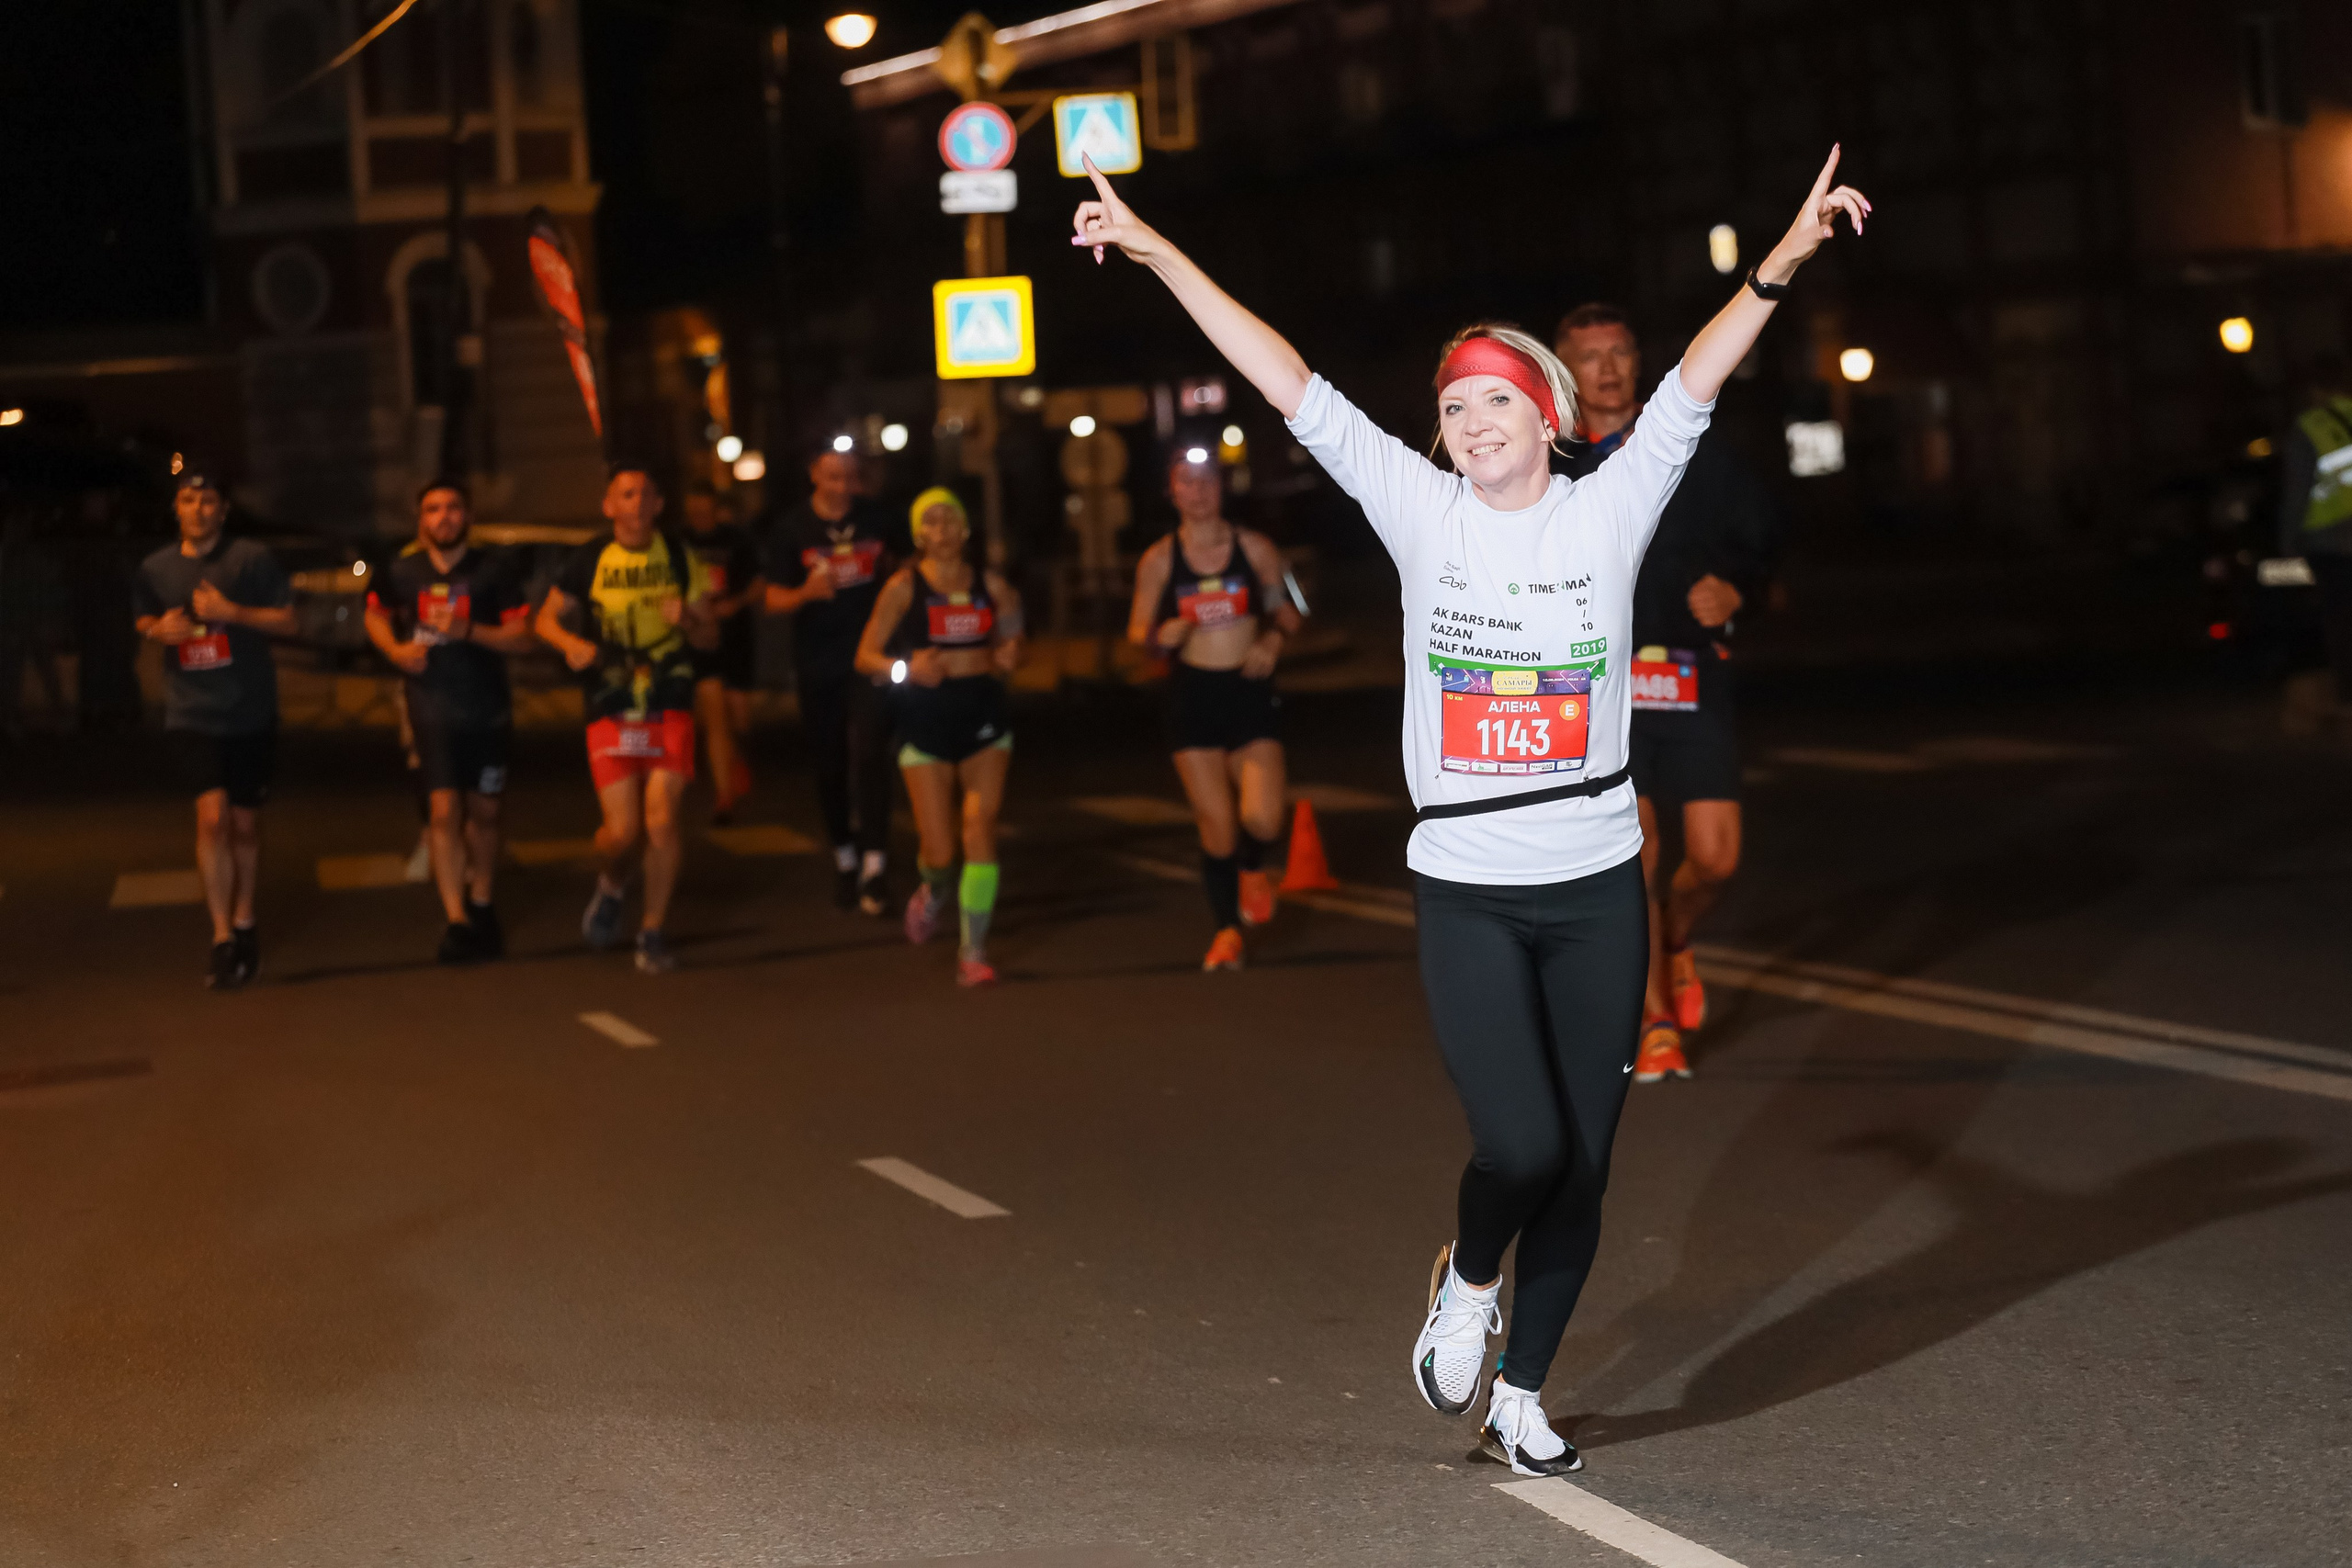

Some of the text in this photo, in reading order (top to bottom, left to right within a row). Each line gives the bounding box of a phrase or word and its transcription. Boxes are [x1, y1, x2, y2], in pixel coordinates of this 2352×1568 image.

[1576, 597, 1588, 606] 06
[1432, 606, 1522, 632] AK BARS BANK
[1580, 622, 1593, 631] 10
[1430, 622, 1473, 640] KAZAN
[1430, 637, 1541, 661] HALF MARATHON
[1572, 639, 1605, 656] 2019
[1487, 701, 1541, 713] АЛЕНА
[1476, 718, 1551, 756] 1143
